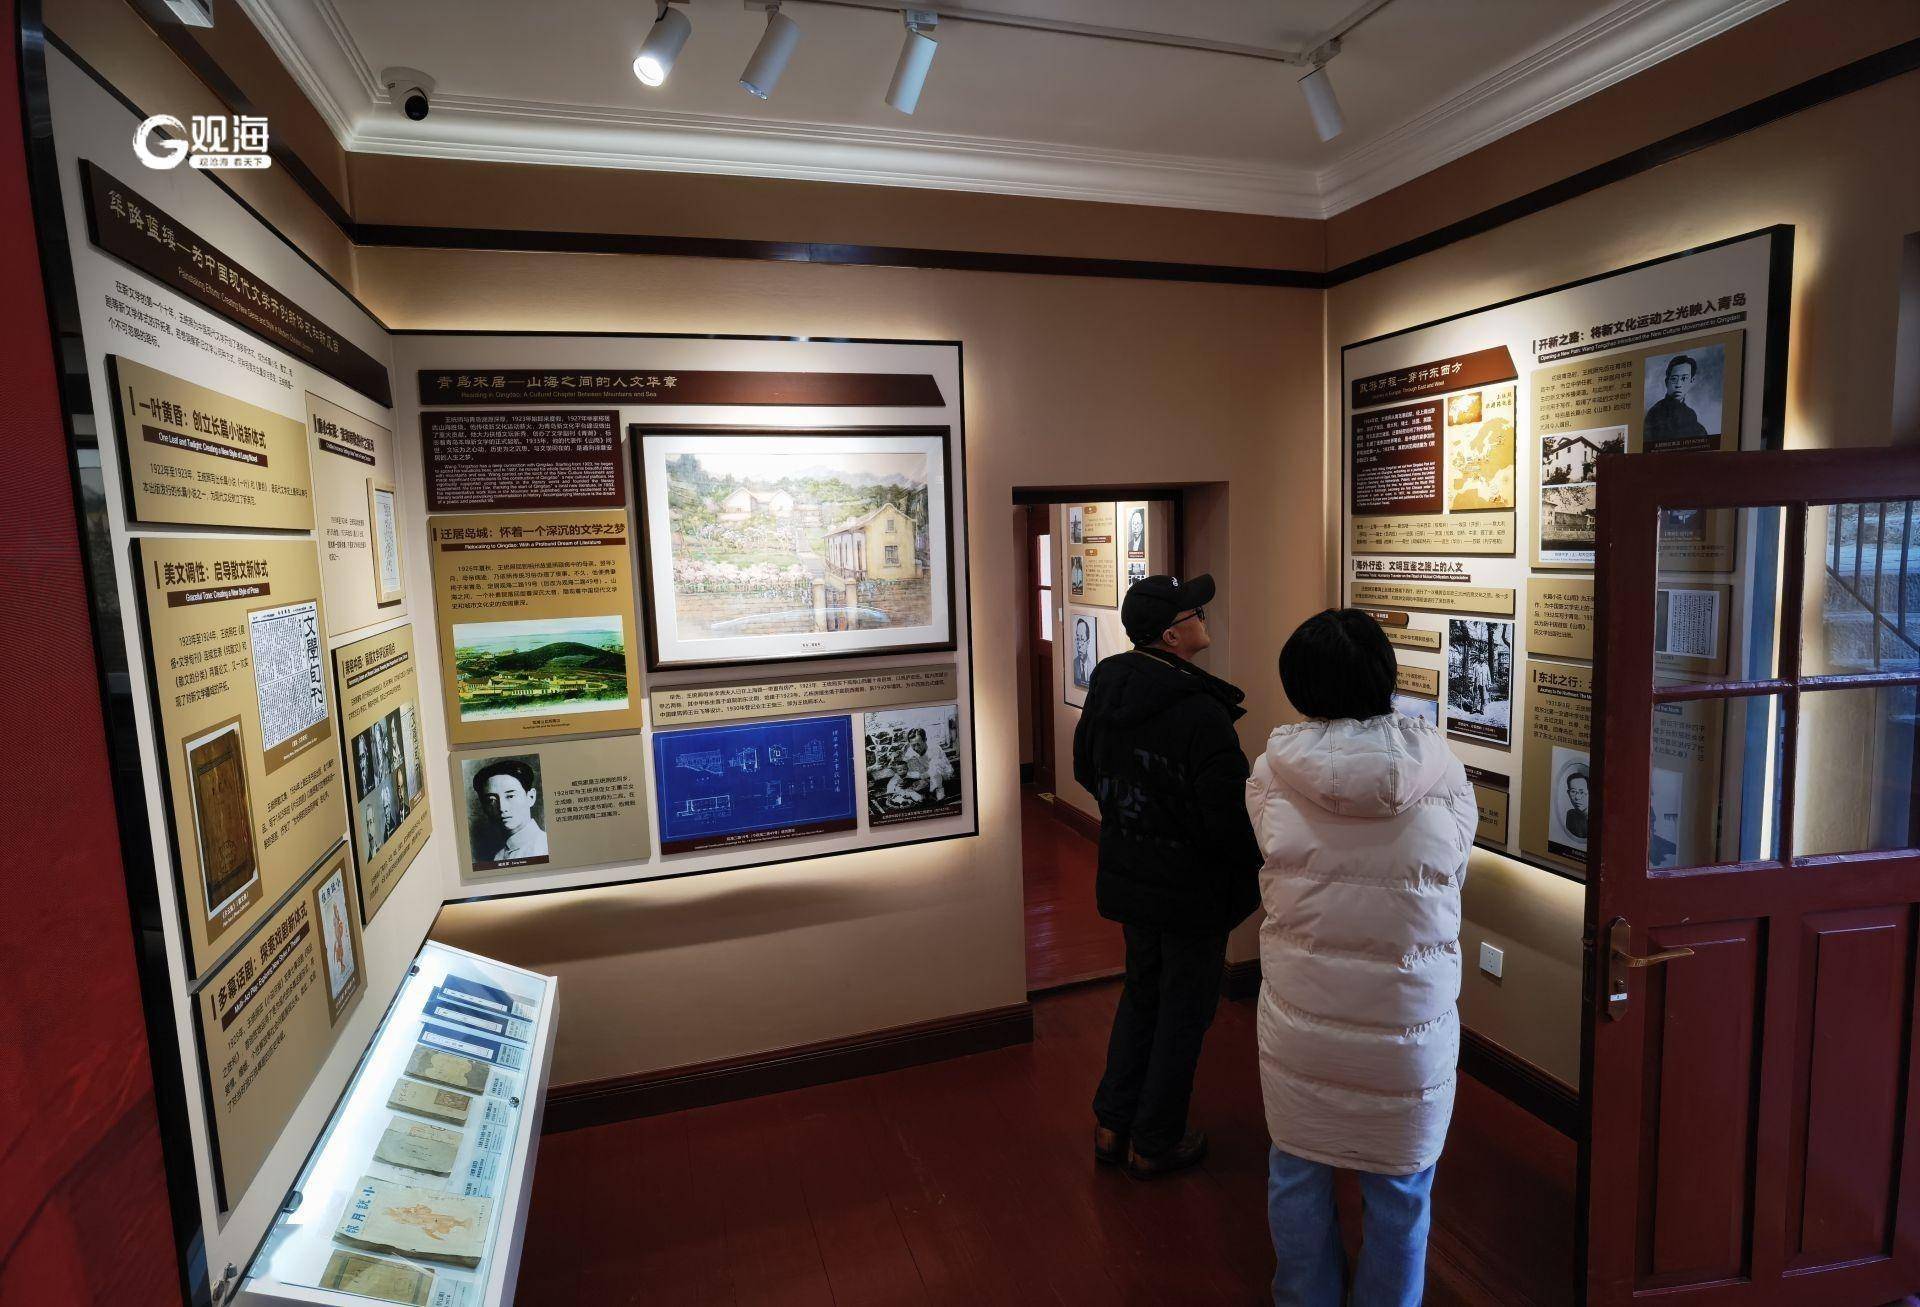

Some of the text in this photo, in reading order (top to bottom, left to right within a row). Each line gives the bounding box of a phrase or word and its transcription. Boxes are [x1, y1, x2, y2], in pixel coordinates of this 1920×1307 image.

[1538, 292, 1746, 351] 开新之路：将新文化运动之光映入青岛
[553, 391, 575, 399] Chapter
[159, 432, 168, 442] One
[179, 437, 187, 445] and
[441, 523, 625, 541] 迁居岛城：怀着一个深沉的文学之梦
[164, 560, 268, 585] 美文调性：启导散文新体式
